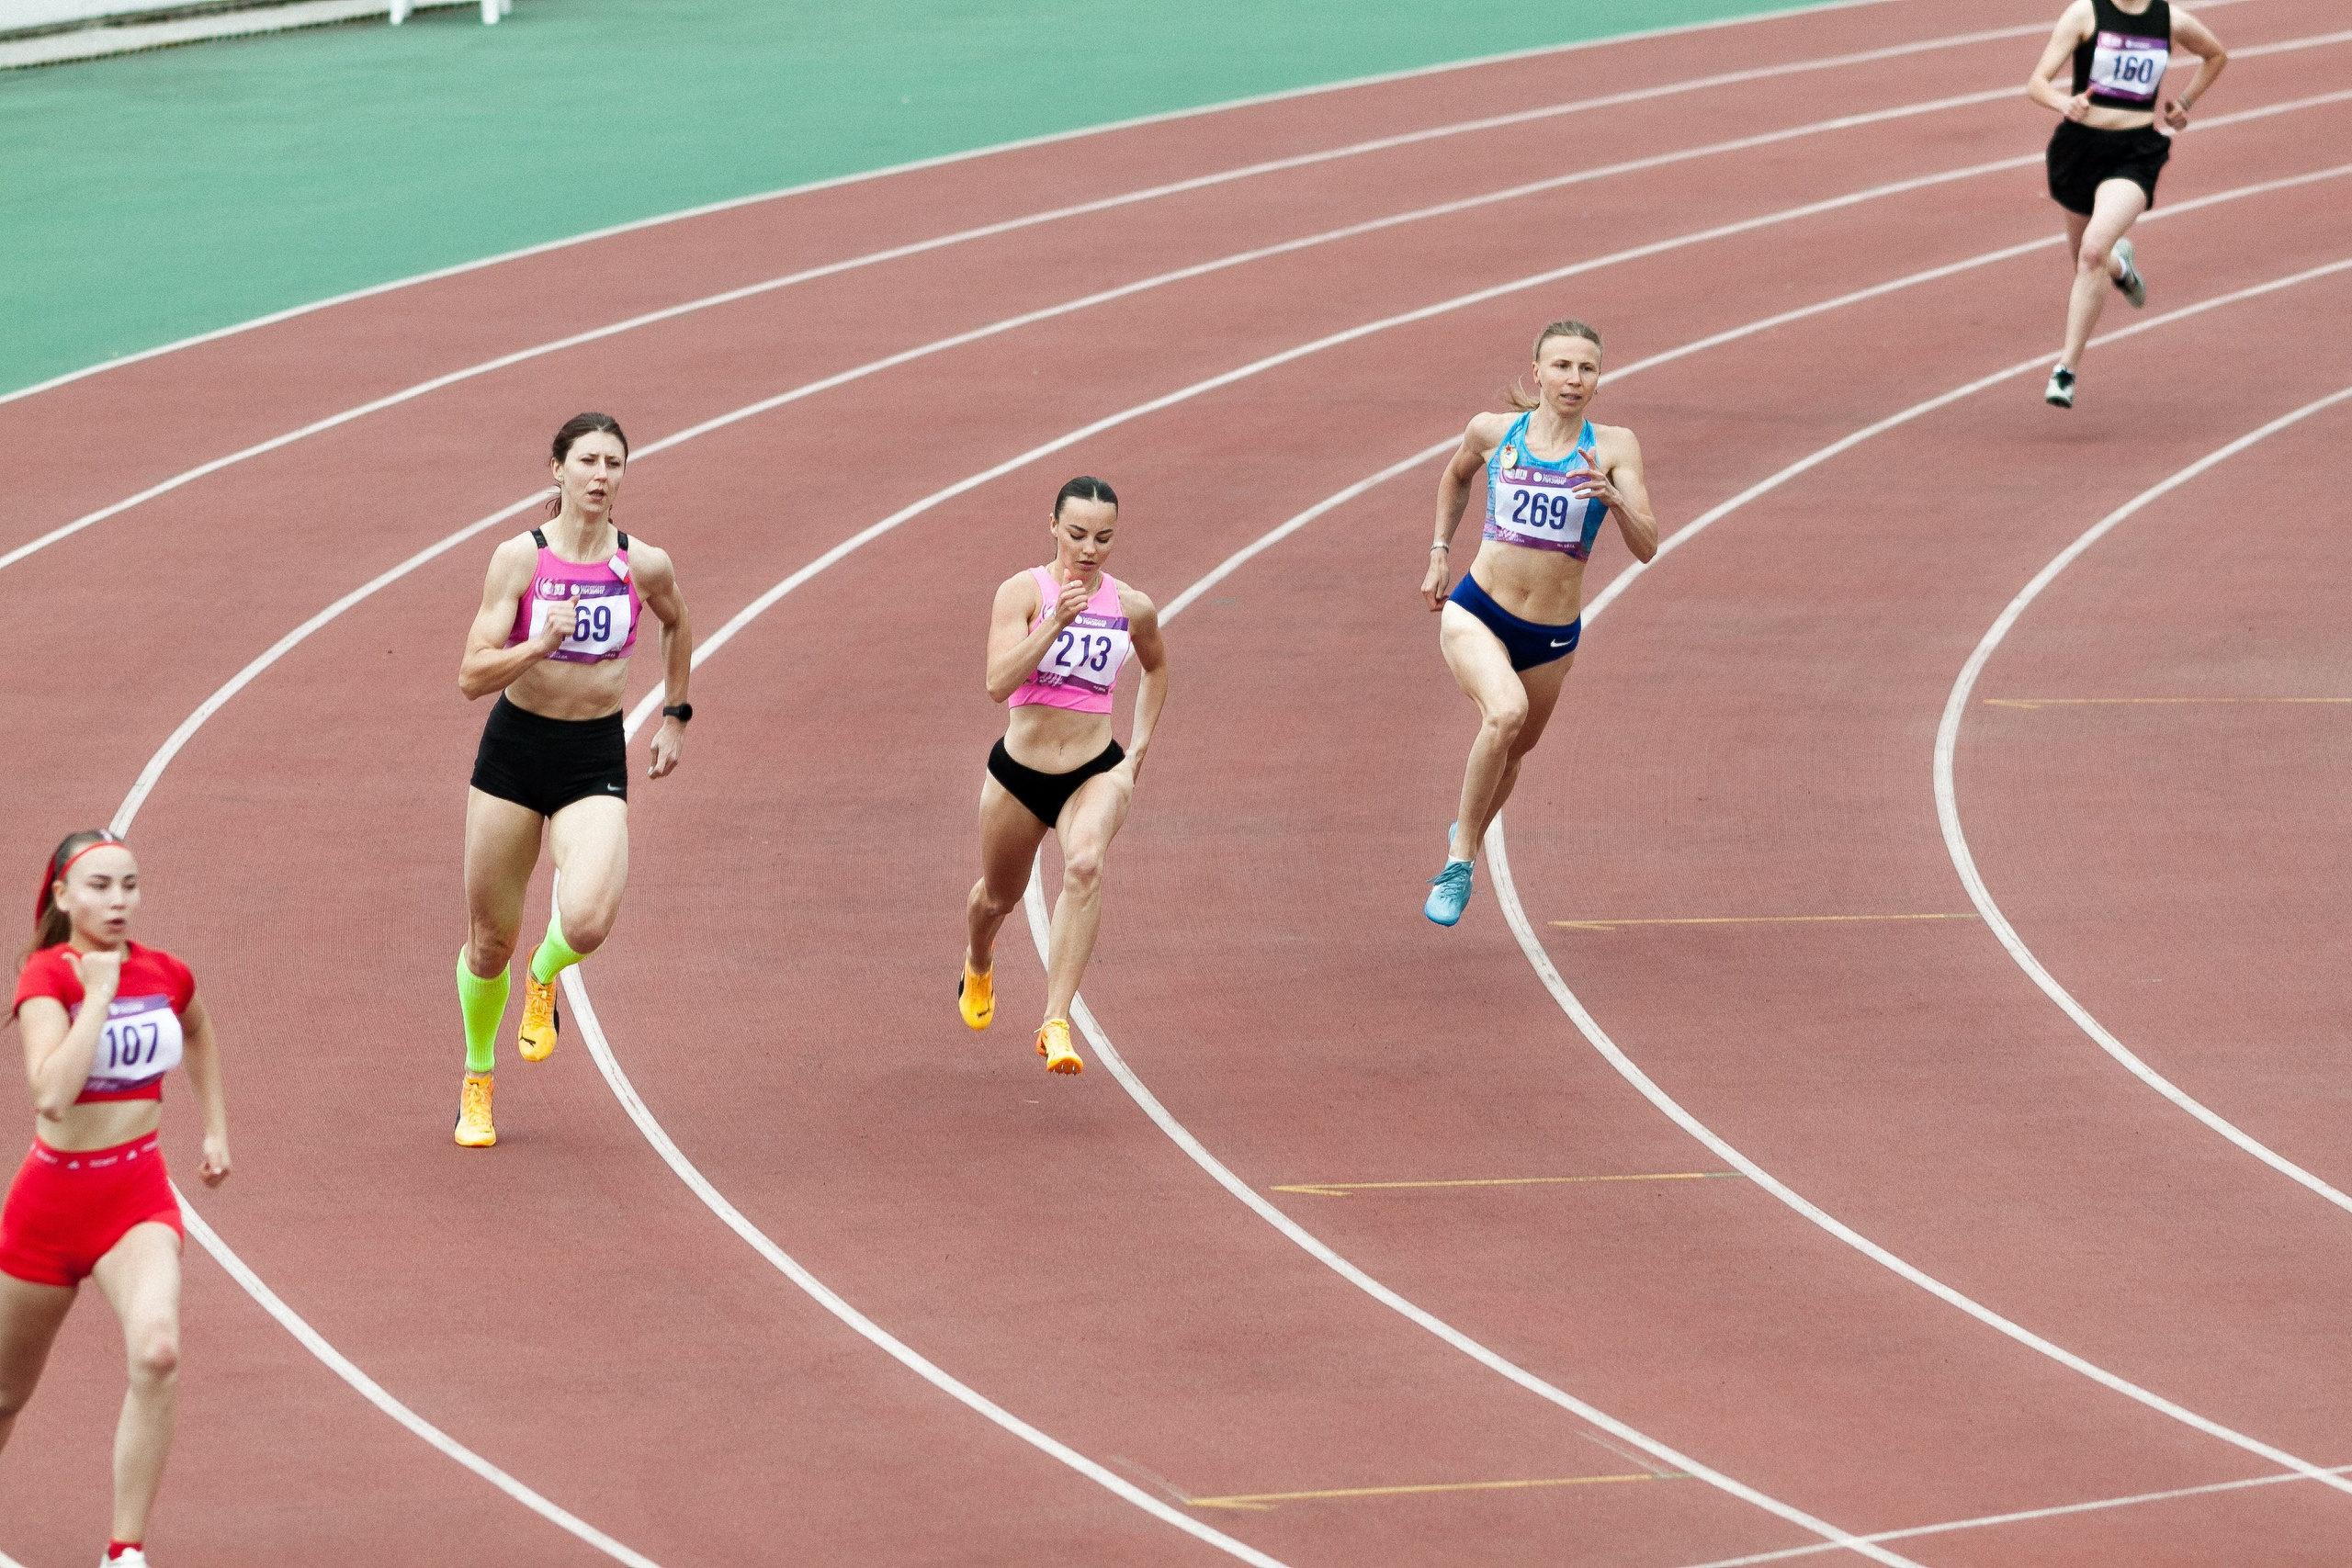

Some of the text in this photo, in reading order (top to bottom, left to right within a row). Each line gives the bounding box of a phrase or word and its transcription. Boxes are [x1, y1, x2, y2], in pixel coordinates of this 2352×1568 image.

[2113, 55, 2154, 84] 160
[1511, 489, 1568, 530] 269
[561, 605, 611, 642] 69
[1055, 630, 1112, 672] 213
[106, 1022, 158, 1069] 107
